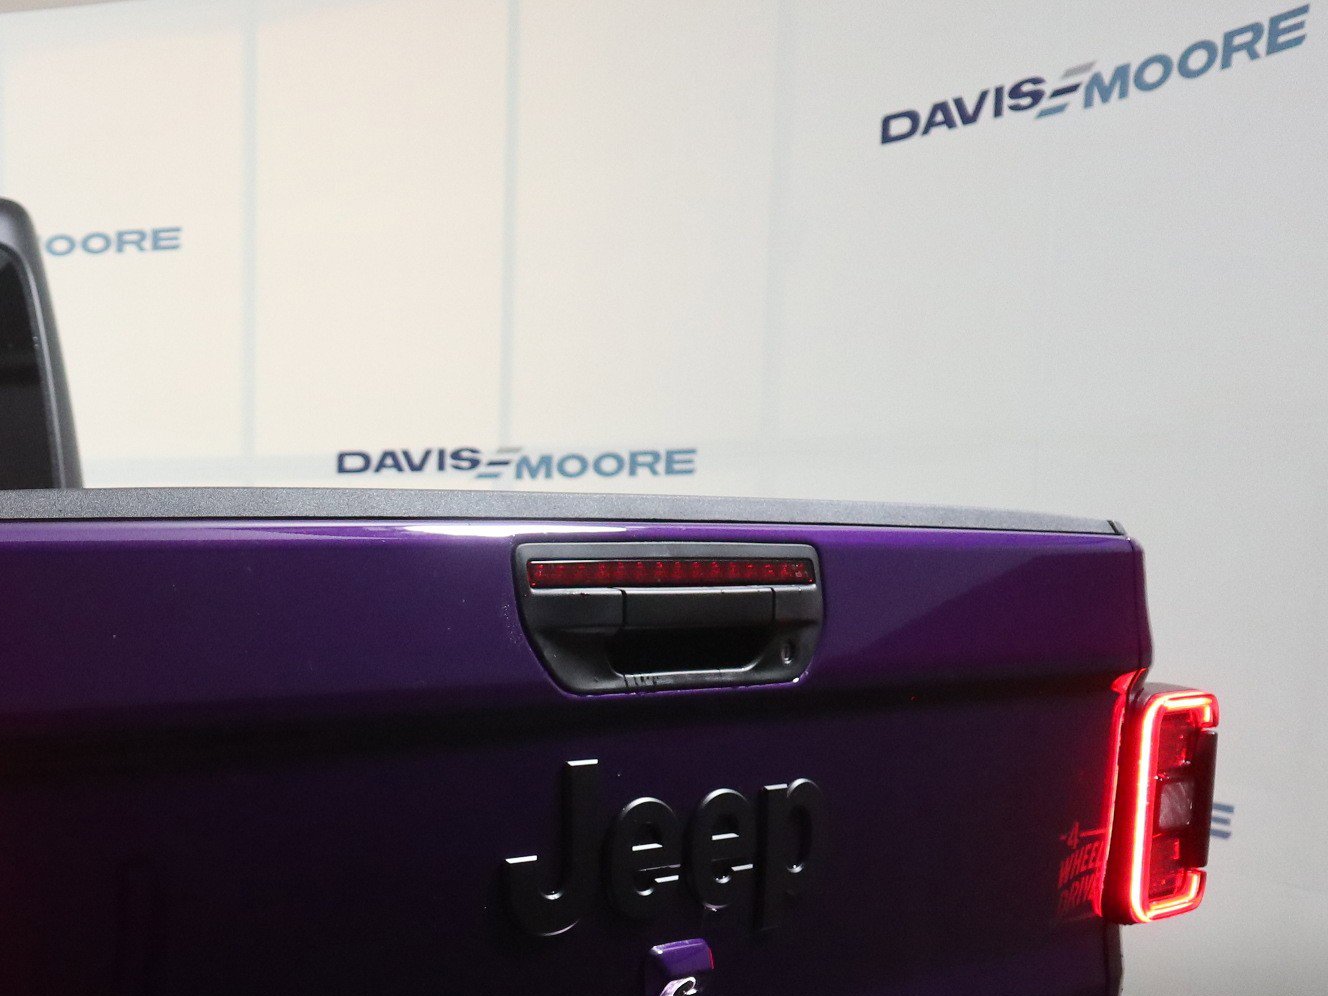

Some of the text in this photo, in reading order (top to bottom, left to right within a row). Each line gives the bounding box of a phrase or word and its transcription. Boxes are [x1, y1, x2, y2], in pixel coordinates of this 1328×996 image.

[880, 3, 1311, 145] DAVIS MOORE
[45, 226, 183, 257] OORE
[336, 447, 698, 481] DAVIS MOORE
[503, 758, 823, 936] Jeep
